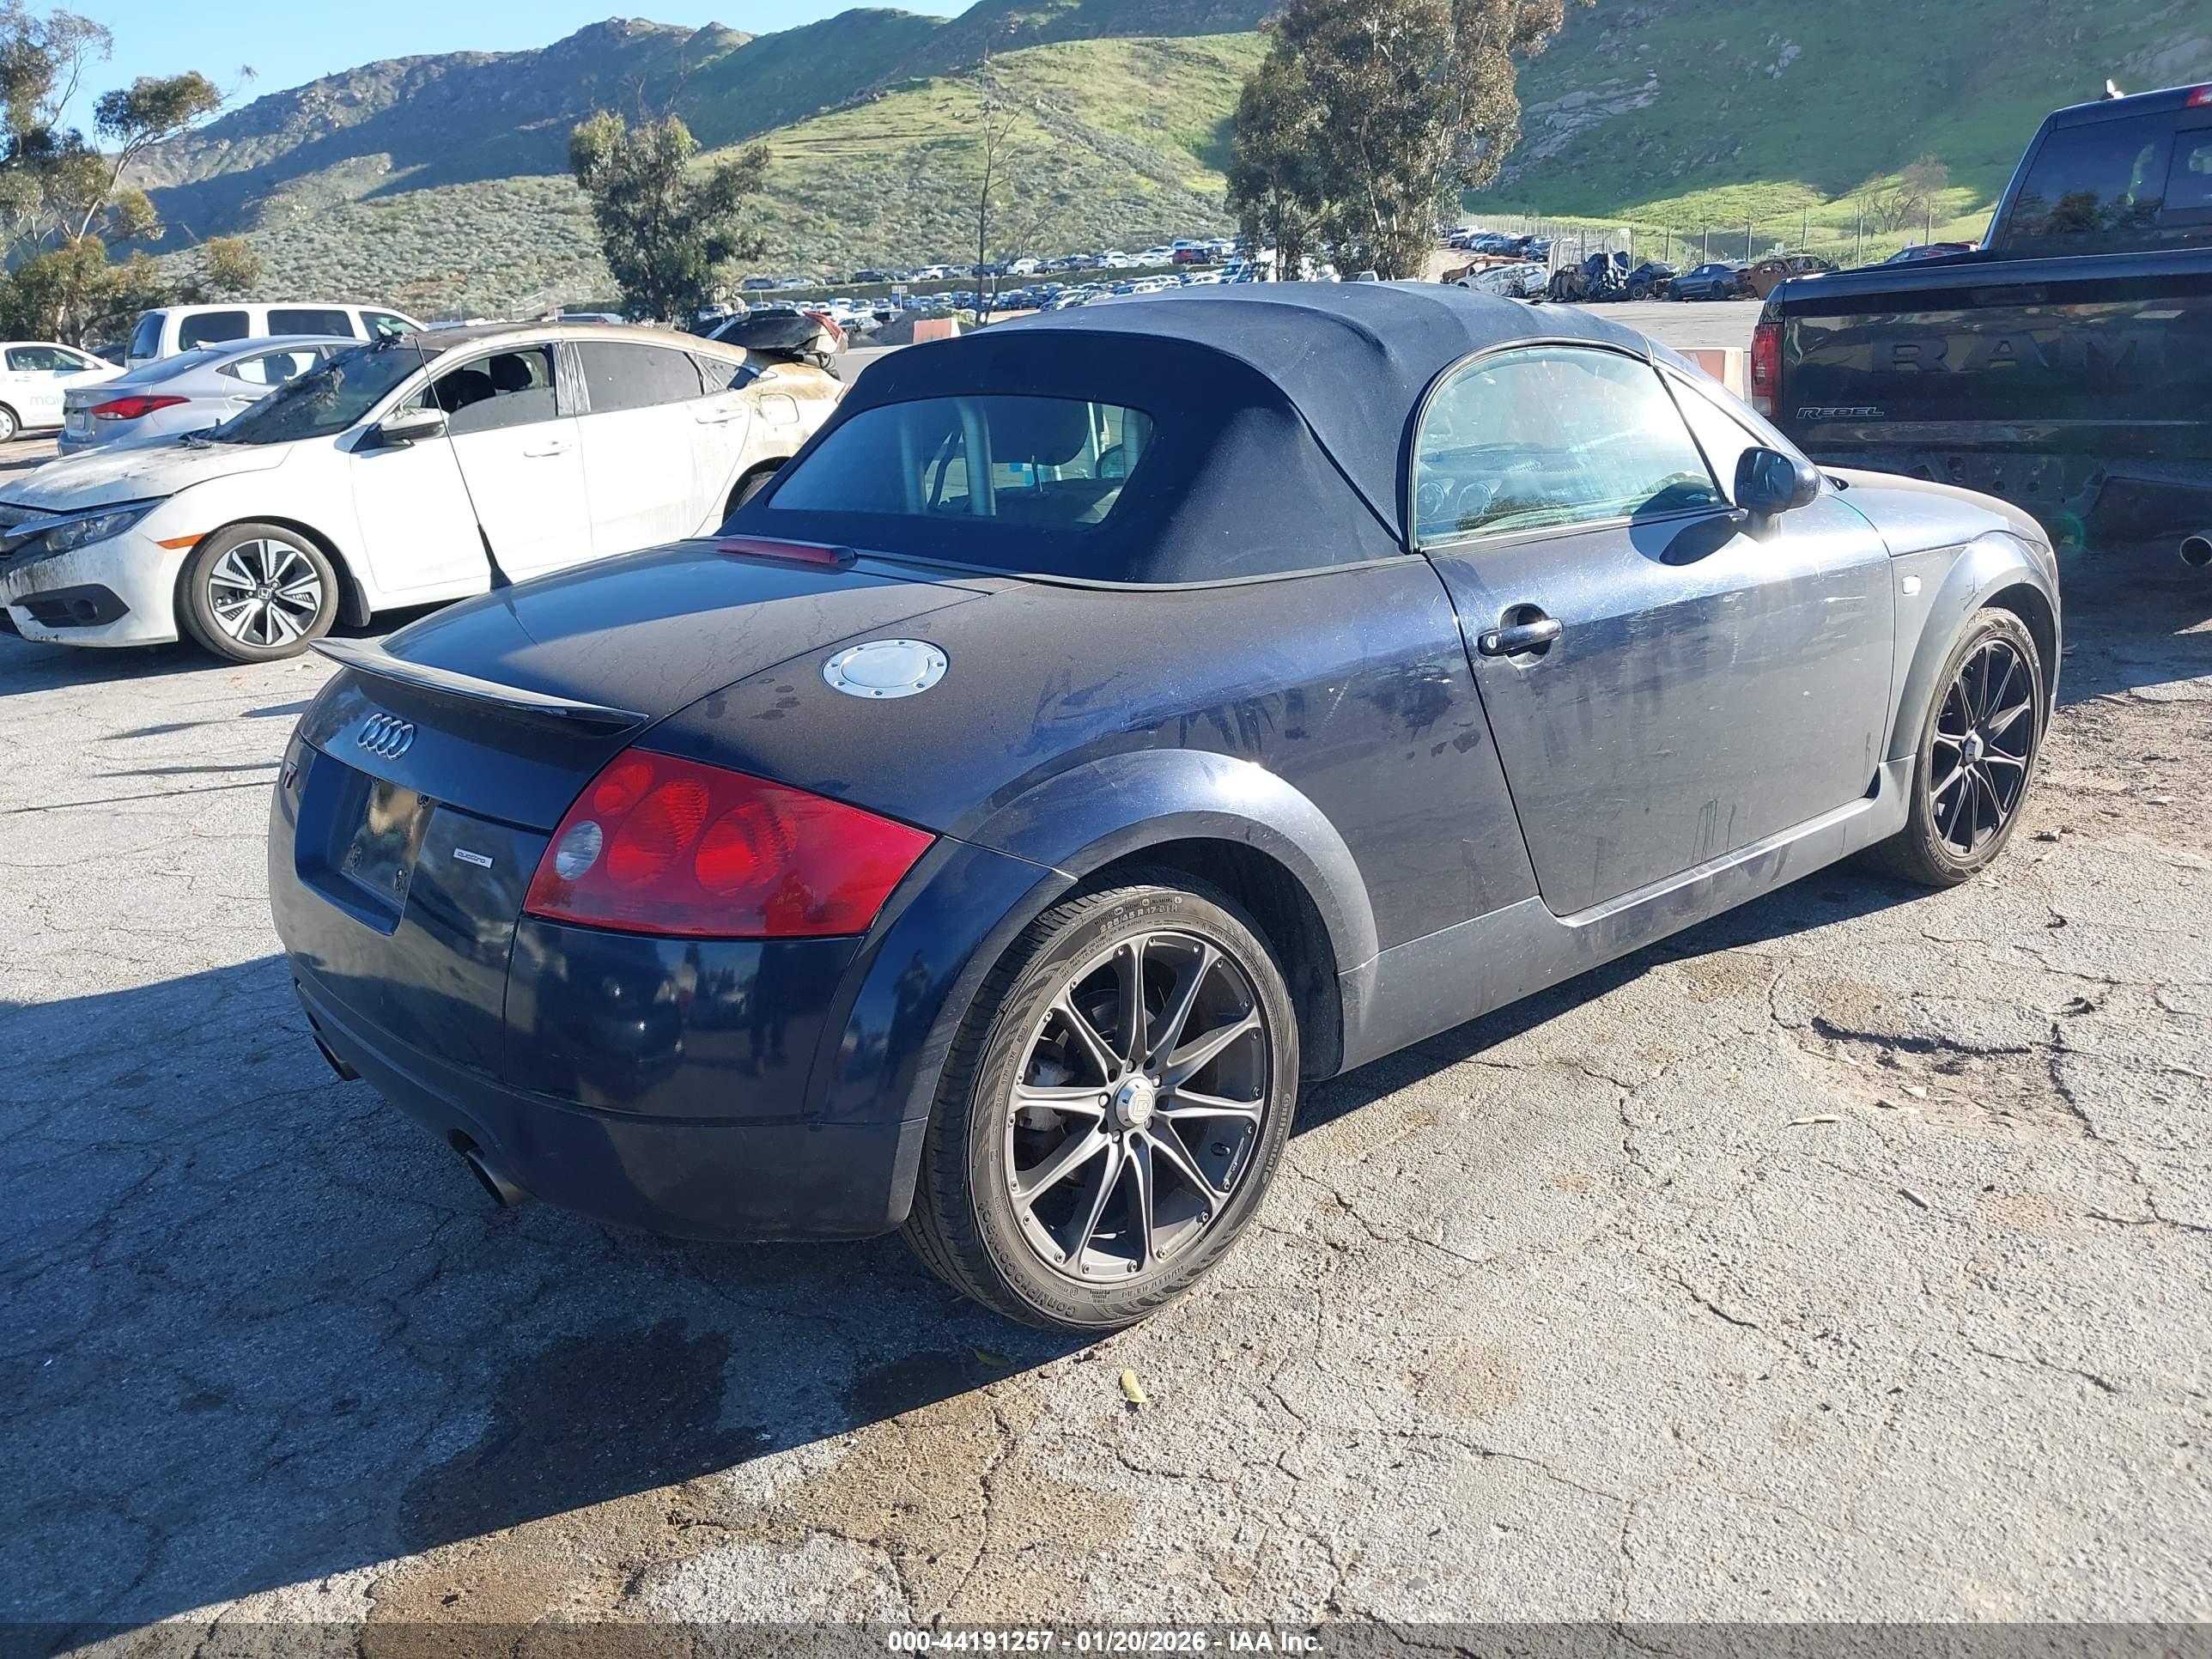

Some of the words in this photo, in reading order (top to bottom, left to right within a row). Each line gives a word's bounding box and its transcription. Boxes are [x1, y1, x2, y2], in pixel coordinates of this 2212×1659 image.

[1872, 328, 2166, 372] RAM
[1796, 406, 1885, 420] REBEL
[1924, 836, 1952, 874] SENTURY
[1100, 910, 1135, 933] 225/45
[1137, 908, 1145, 918] R
